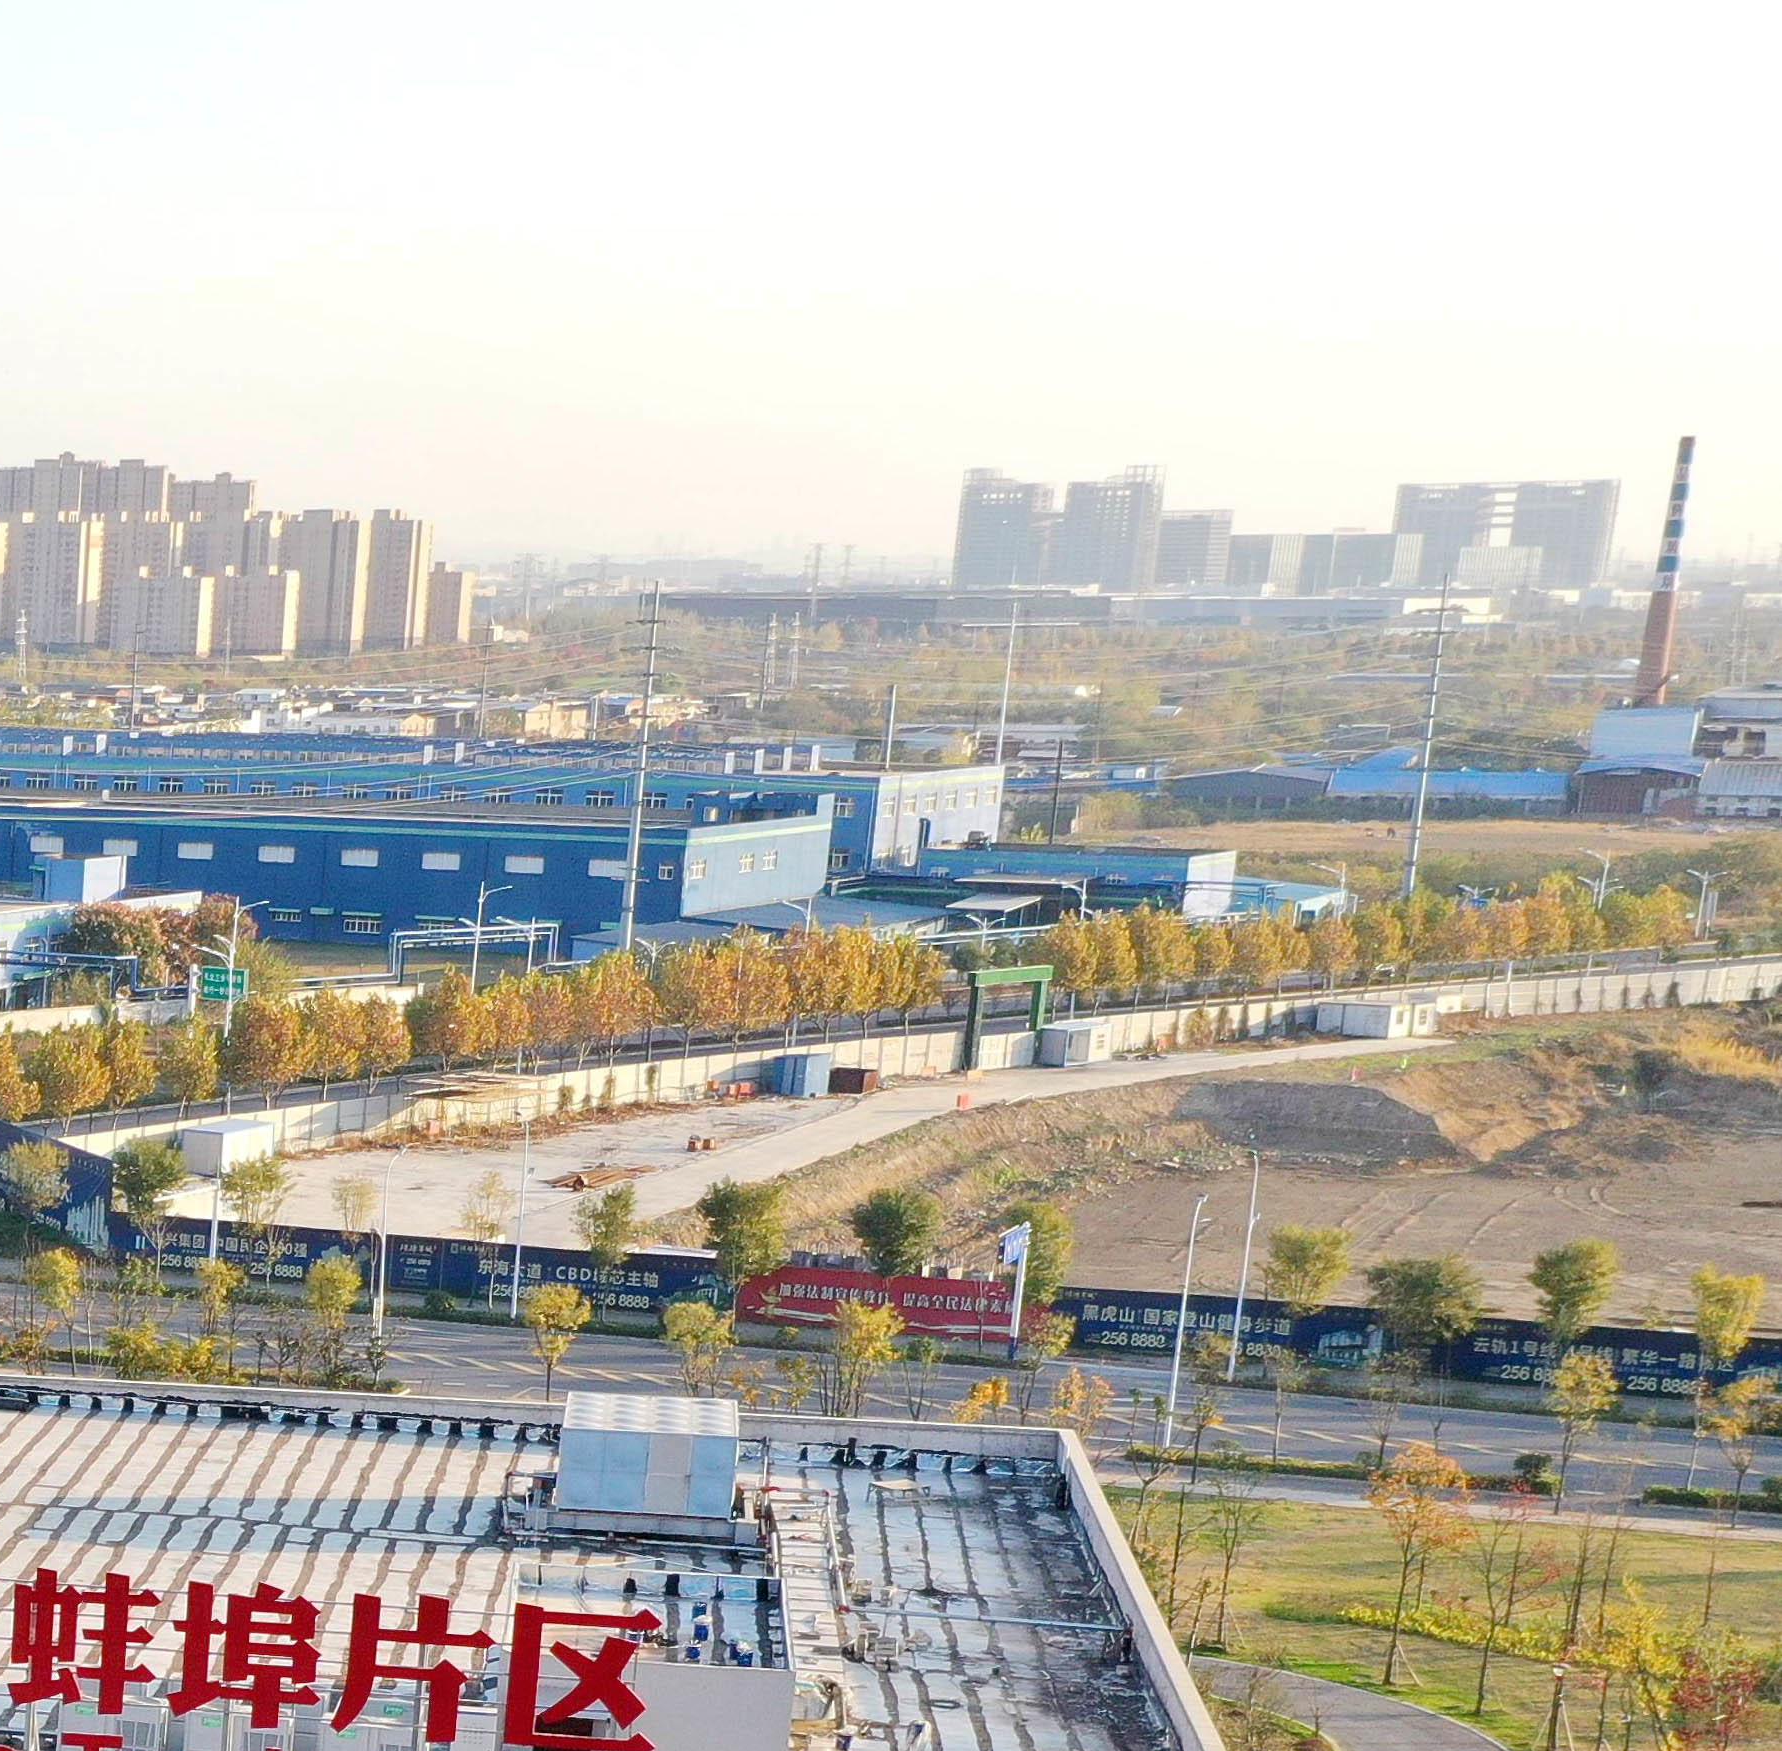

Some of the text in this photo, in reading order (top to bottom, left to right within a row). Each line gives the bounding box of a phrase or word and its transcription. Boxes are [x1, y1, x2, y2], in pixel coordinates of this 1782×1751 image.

[275, 1264, 303, 1278] 8888
[618, 1294, 649, 1309] 8888
[1100, 1331, 1128, 1346] 256
[1500, 1364, 1531, 1381] 256
[1627, 1376, 1657, 1391] 256
